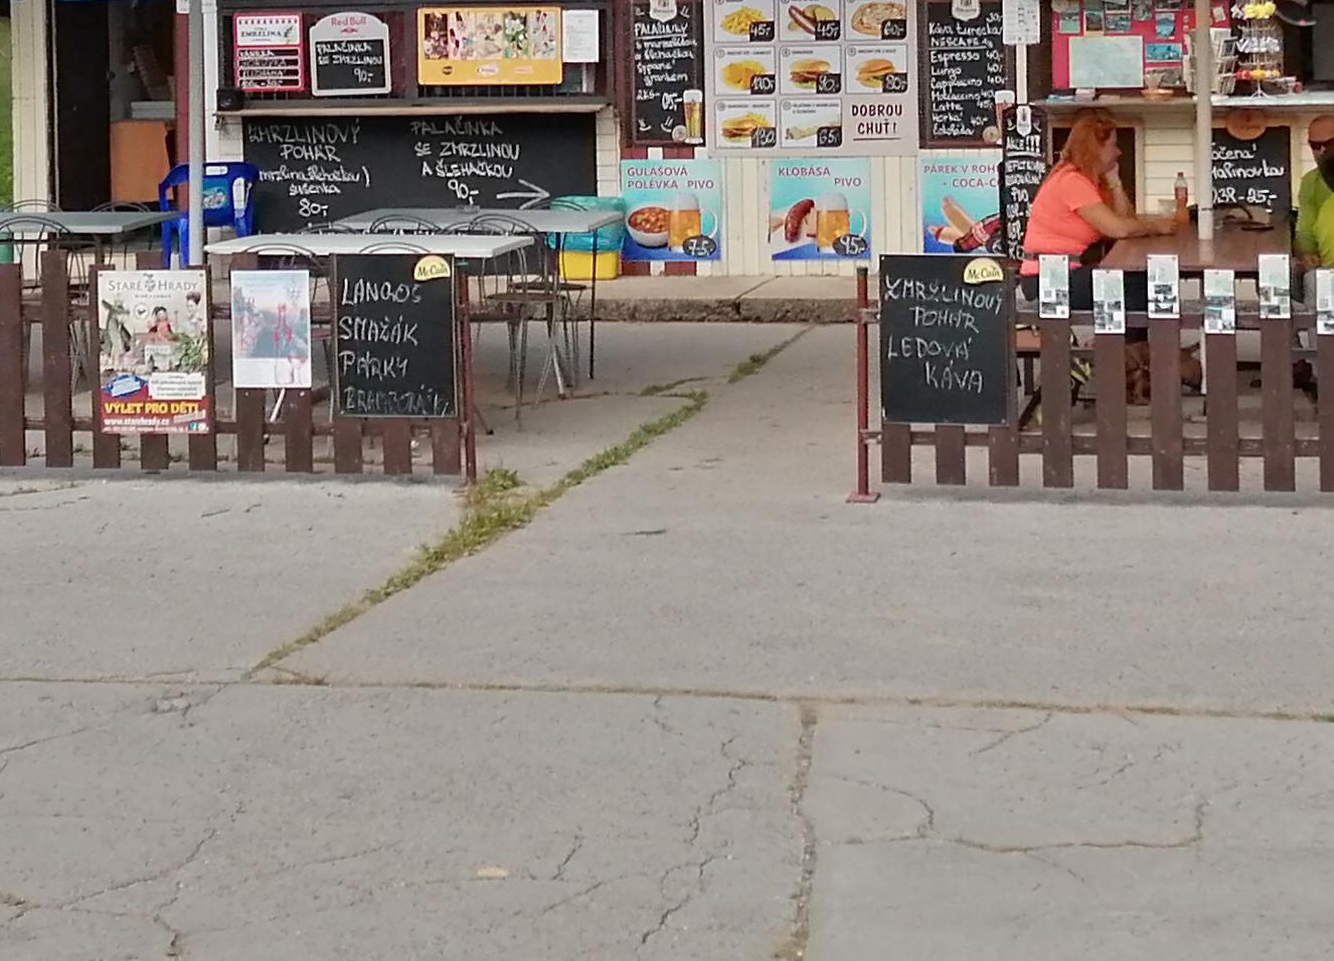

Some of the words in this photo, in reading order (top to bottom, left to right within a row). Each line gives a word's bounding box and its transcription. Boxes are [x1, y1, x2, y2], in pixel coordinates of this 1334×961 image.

[331, 17, 348, 26] Red
[349, 16, 366, 25] Bull
[930, 50, 980, 68] Espresso
[931, 66, 962, 81] Lungo
[851, 104, 903, 117] DOBROU
[410, 115, 504, 136] PALAČINKA
[279, 143, 342, 162] POHÁR
[414, 141, 433, 157] SE
[438, 141, 521, 160] ZMRZLINOU
[1212, 143, 1257, 160] očená
[421, 161, 433, 177] A
[435, 158, 513, 178] ŠLEHAČKOU
[778, 164, 831, 176] KLOBÁSA
[961, 164, 969, 173] V
[687, 179, 714, 189] PIVO
[834, 177, 862, 187] PIVO
[952, 178, 997, 188] COCA-C
[924, 359, 984, 394] KÁVA
[104, 400, 144, 414] VÝLET
[145, 402, 168, 414] PRO
[170, 400, 199, 414] DĚTI
